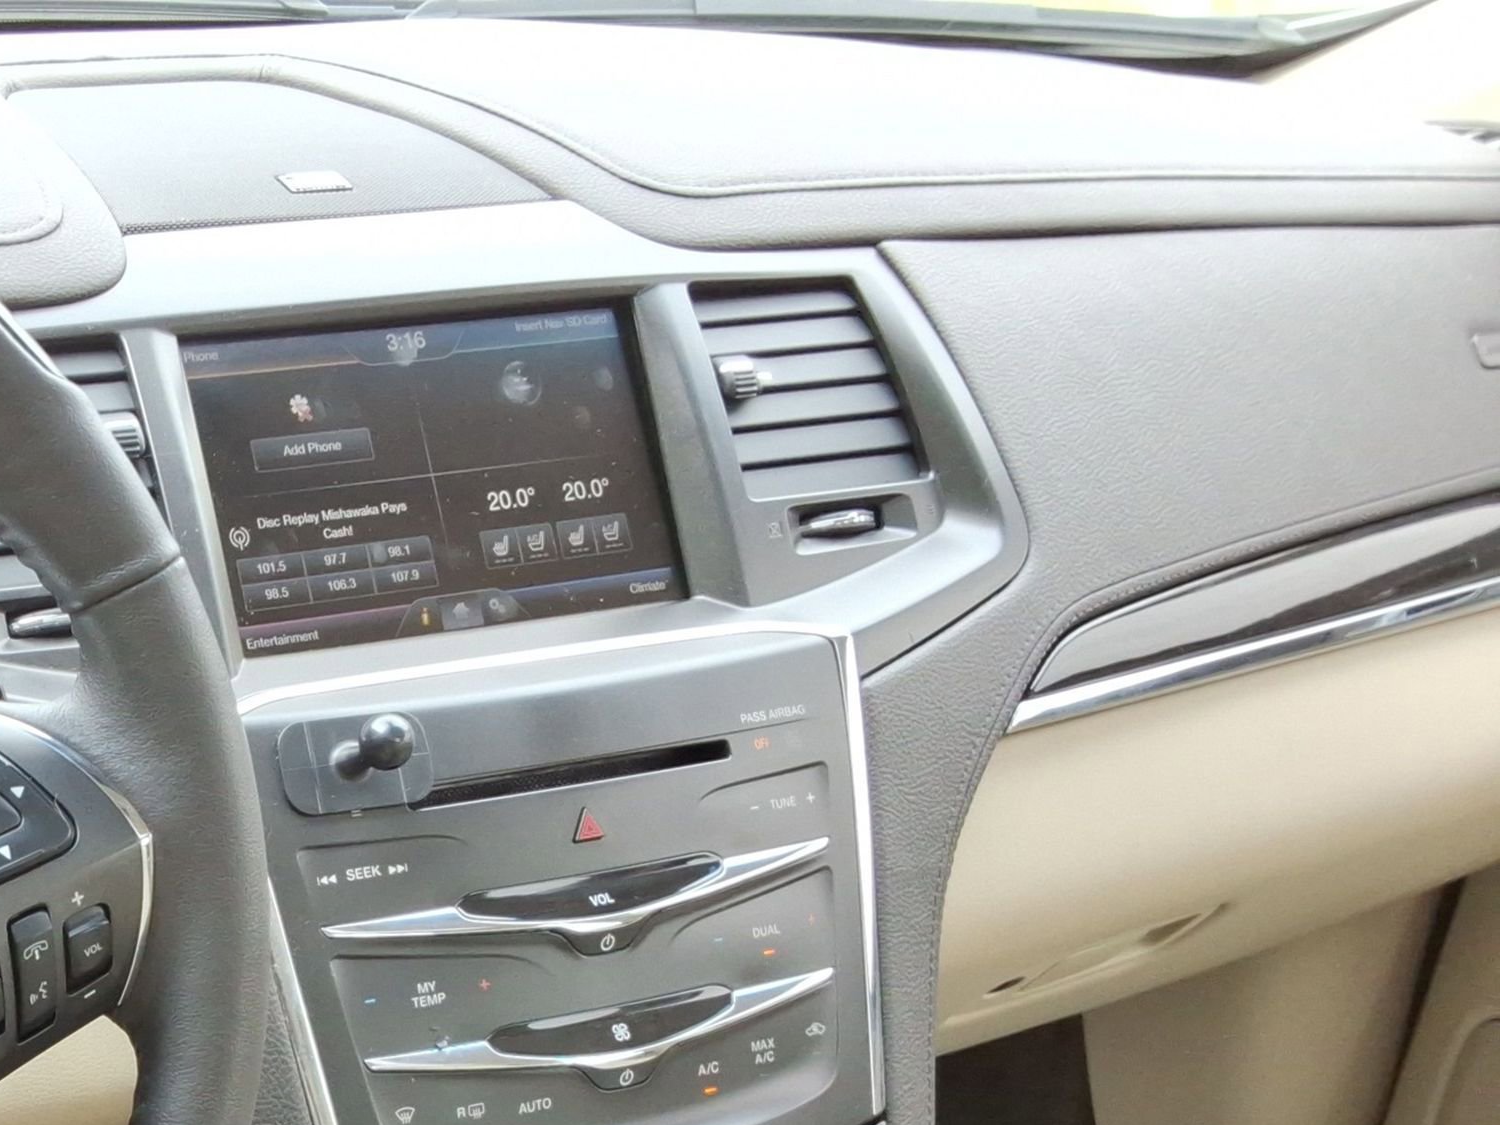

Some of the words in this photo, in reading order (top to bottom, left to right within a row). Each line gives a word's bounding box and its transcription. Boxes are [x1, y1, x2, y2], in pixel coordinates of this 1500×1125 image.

[385, 331, 426, 352] 3:16
[183, 350, 219, 363] Phone
[283, 443, 306, 457] Add
[307, 440, 342, 454] Phone
[562, 477, 609, 502] 20.0°
[487, 487, 536, 512] 20.0°
[257, 516, 281, 530] Disc
[282, 512, 319, 528] Replay
[321, 504, 380, 522] Mishawaka
[381, 502, 408, 515] Pays
[323, 525, 354, 540] Cash!
[387, 544, 411, 558] 98.1
[324, 552, 347, 566] 97.7
[256, 562, 287, 575] 101.5
[391, 569, 420, 583] 107.9
[327, 577, 357, 592] 106.3
[629, 580, 666, 594] Climate
[265, 587, 289, 601] 98.5
[246, 629, 320, 650] Entertainment
[740, 709, 767, 724] PASS
[769, 704, 806, 720] AIRBAG
[770, 795, 797, 809] TUNE
[346, 864, 382, 882] SEEK
[588, 893, 615, 907] VOL
[752, 922, 781, 939] DUAL
[83, 941, 103, 957] VOL
[417, 980, 437, 995] MY
[411, 992, 446, 1009] TEMP
[751, 1038, 776, 1052] MAX
[755, 1050, 775, 1065] A/C
[698, 1061, 720, 1077] A/C
[456, 1107, 467, 1119] R
[518, 1097, 552, 1115] AUTO
